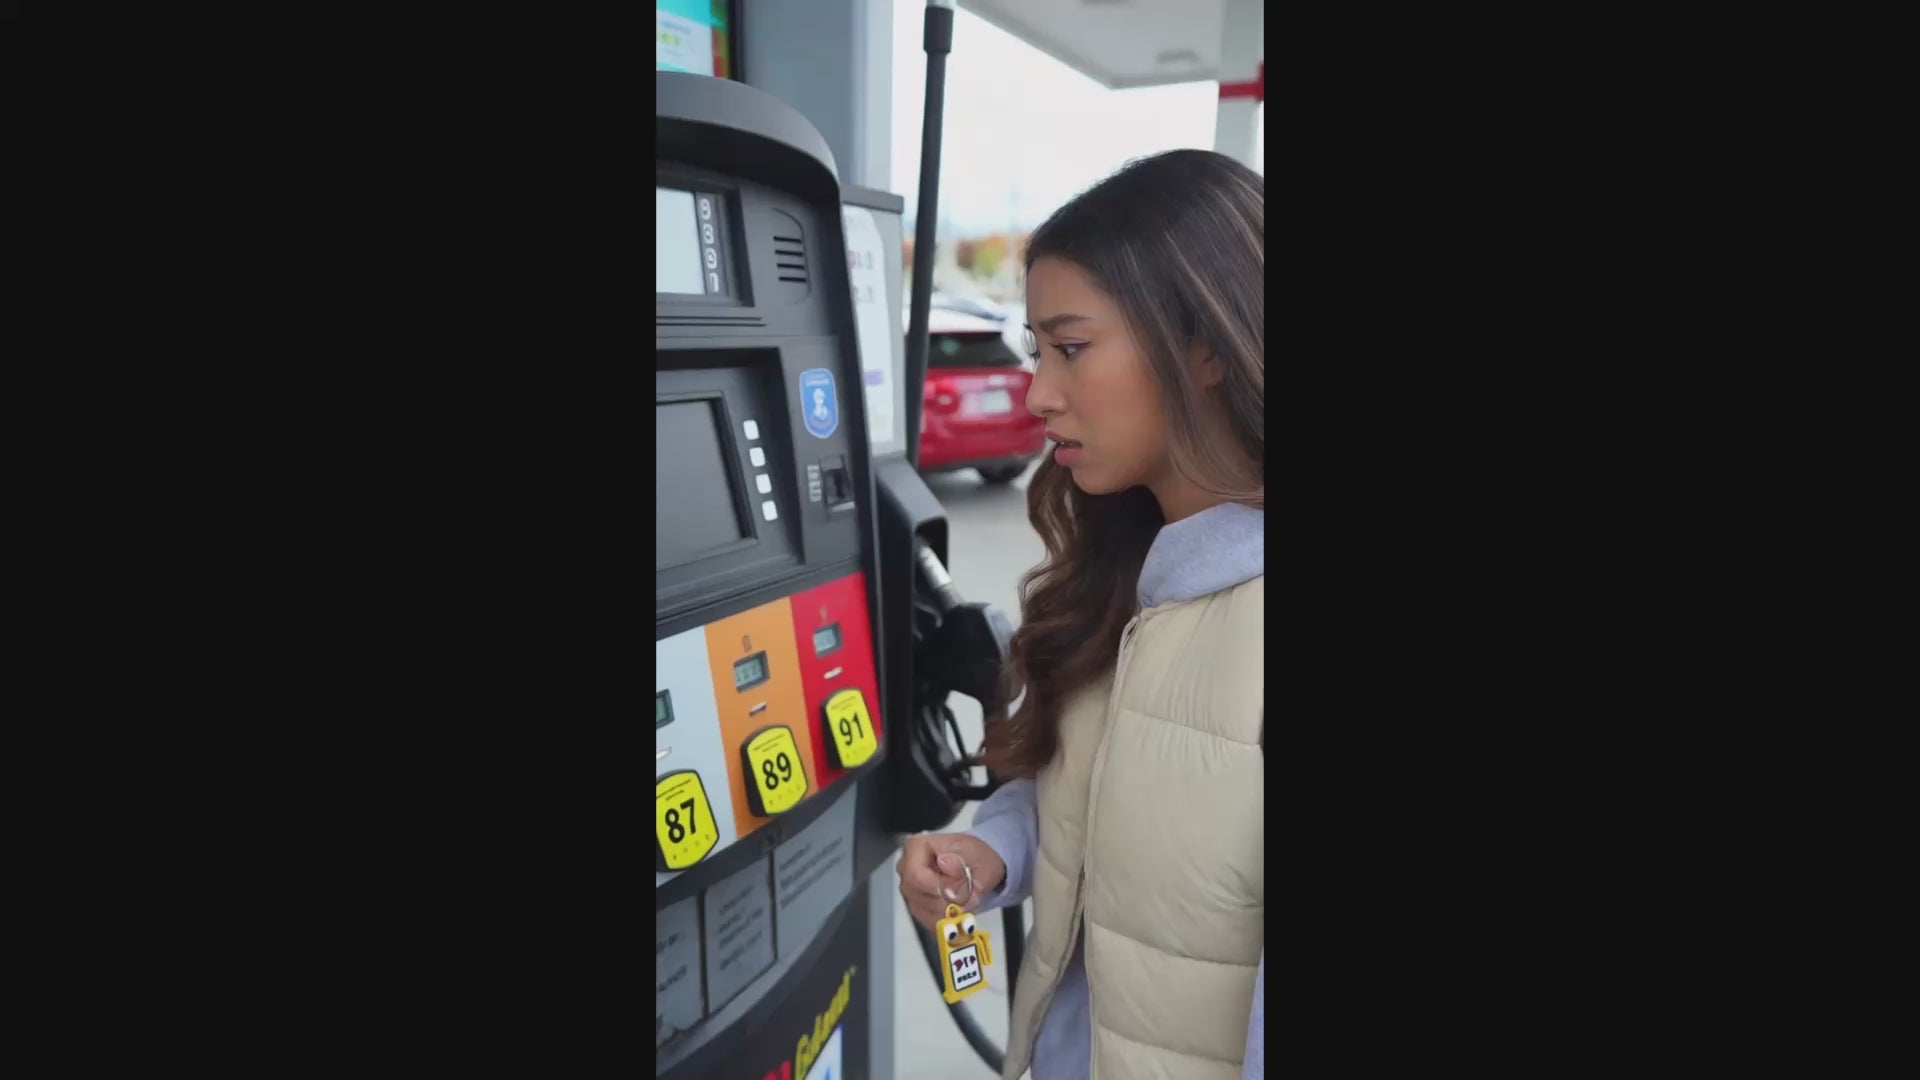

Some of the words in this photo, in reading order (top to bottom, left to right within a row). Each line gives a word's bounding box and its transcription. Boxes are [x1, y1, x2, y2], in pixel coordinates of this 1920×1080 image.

[840, 713, 864, 746] 91
[762, 752, 792, 790] 89
[665, 797, 696, 844] 87
